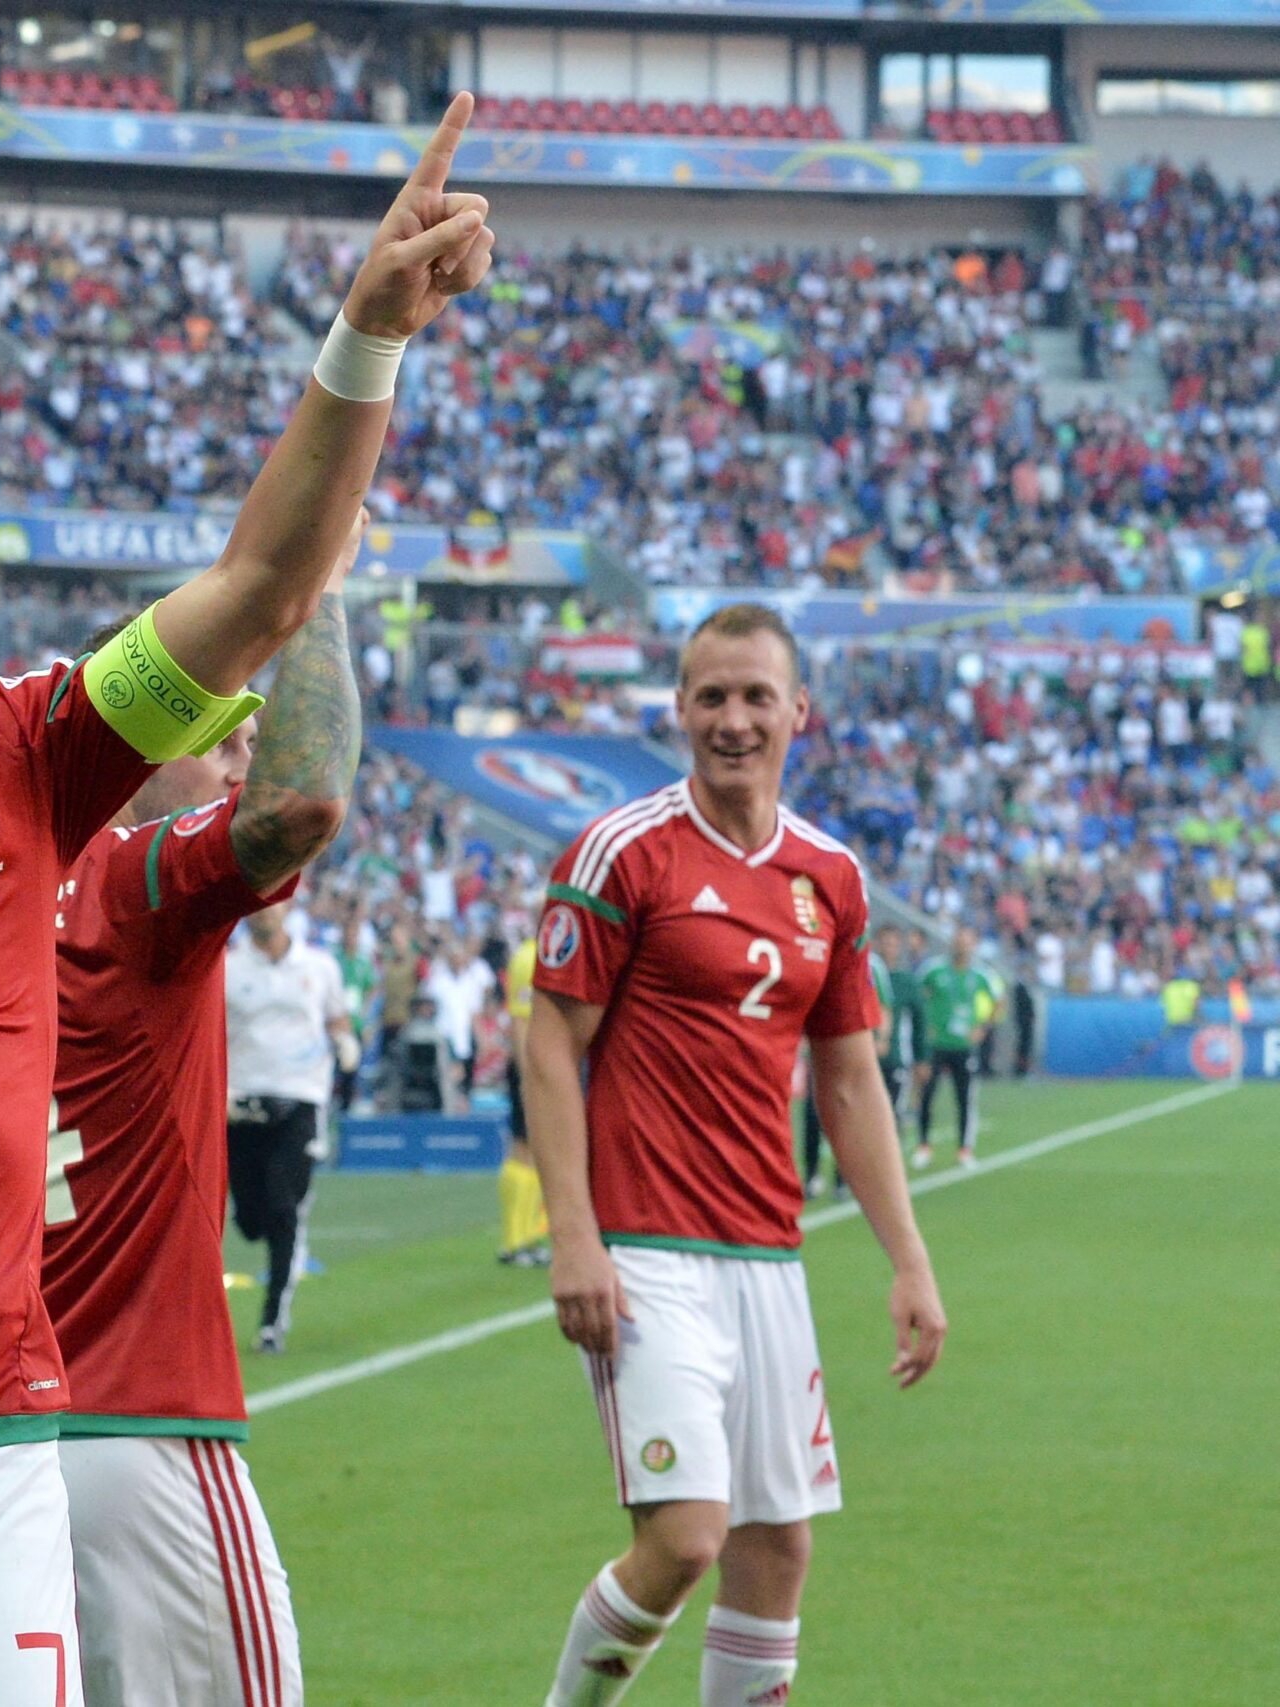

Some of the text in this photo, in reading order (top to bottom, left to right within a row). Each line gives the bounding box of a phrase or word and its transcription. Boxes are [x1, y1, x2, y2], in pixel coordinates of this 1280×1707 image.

[54, 520, 150, 559] UEFA
[147, 674, 170, 700] TO
[170, 698, 201, 723] NO
[738, 938, 783, 1020] 2
[808, 1368, 832, 1446] 2
[14, 1631, 67, 1707] 7
